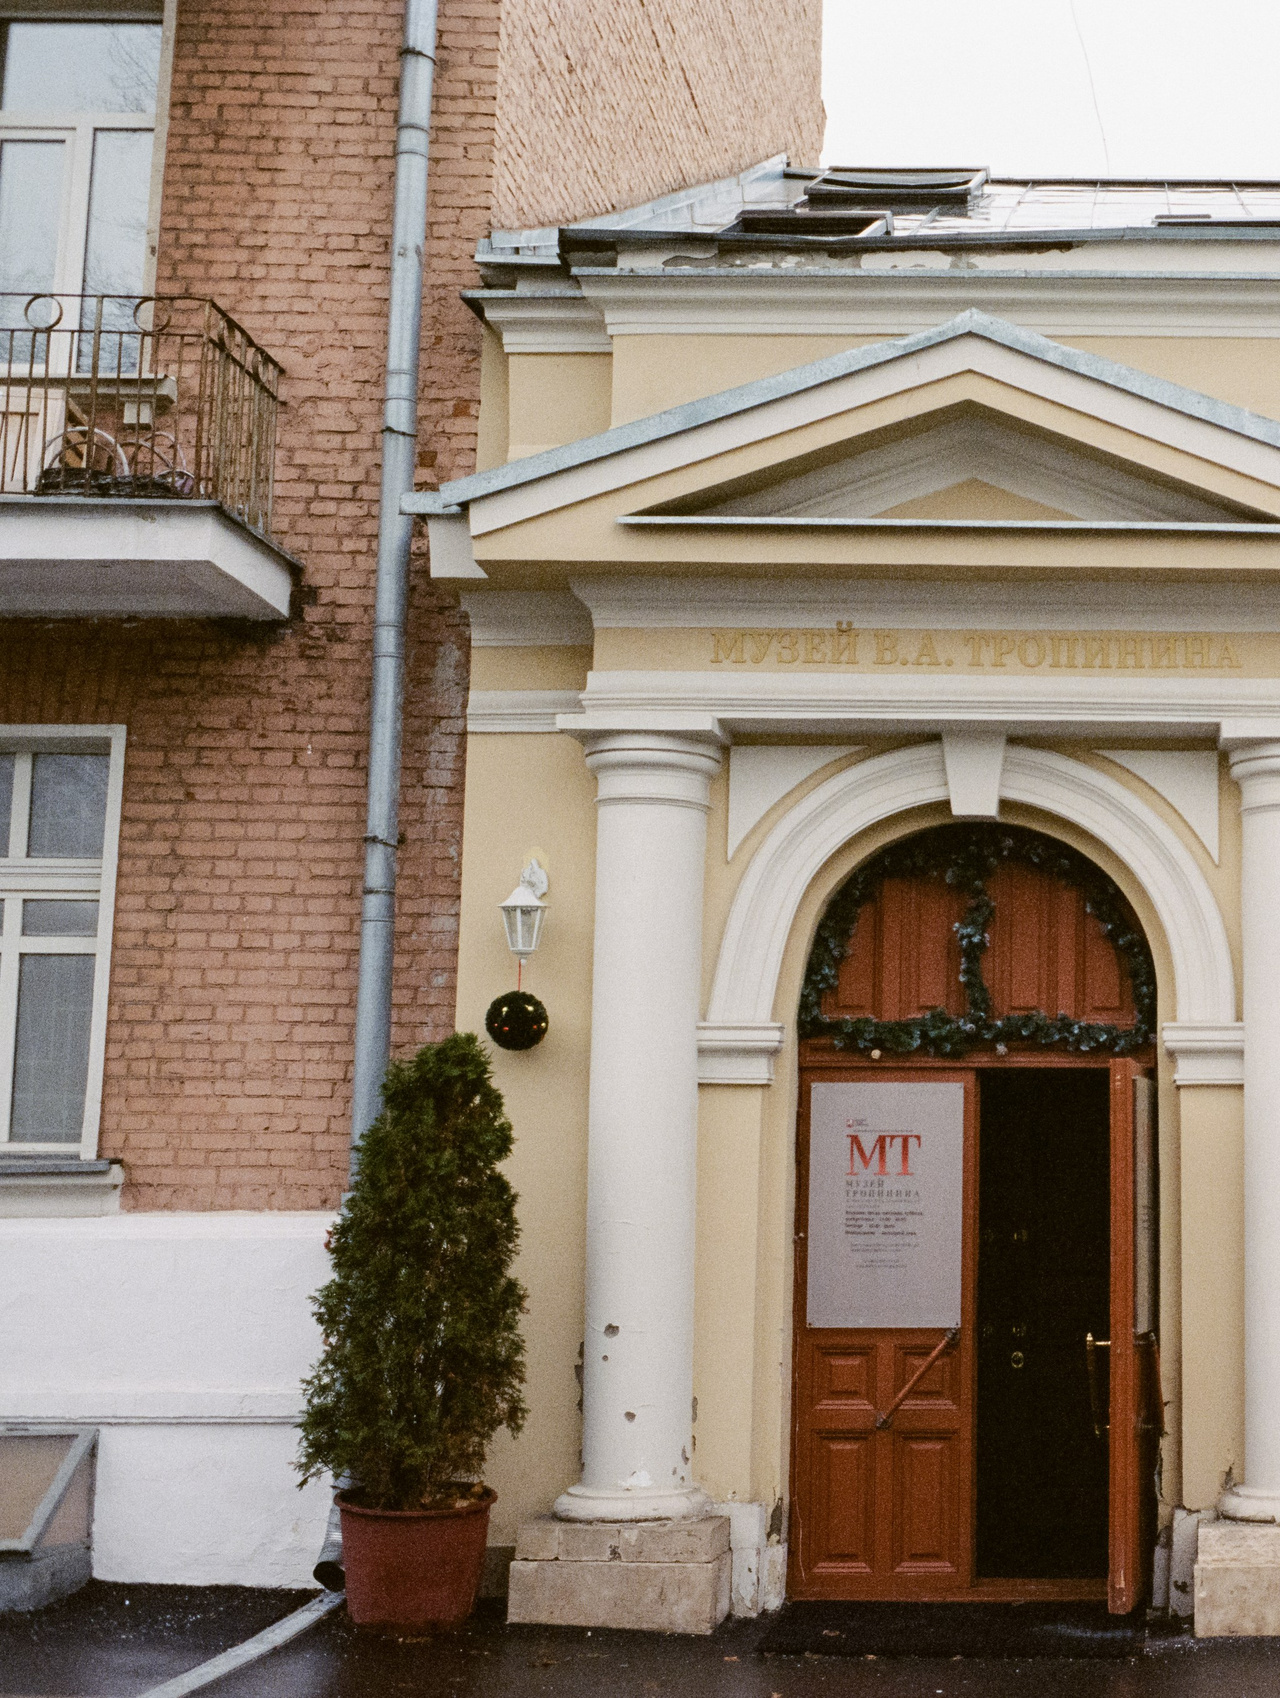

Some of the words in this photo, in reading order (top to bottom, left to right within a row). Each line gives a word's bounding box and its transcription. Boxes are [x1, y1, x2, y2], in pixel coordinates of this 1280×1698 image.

[709, 621, 860, 664] МУЗЕЙ
[873, 634, 954, 667] В.А.
[965, 634, 1243, 669] ТРОПИНИНА
[845, 1134, 922, 1176] МТ
